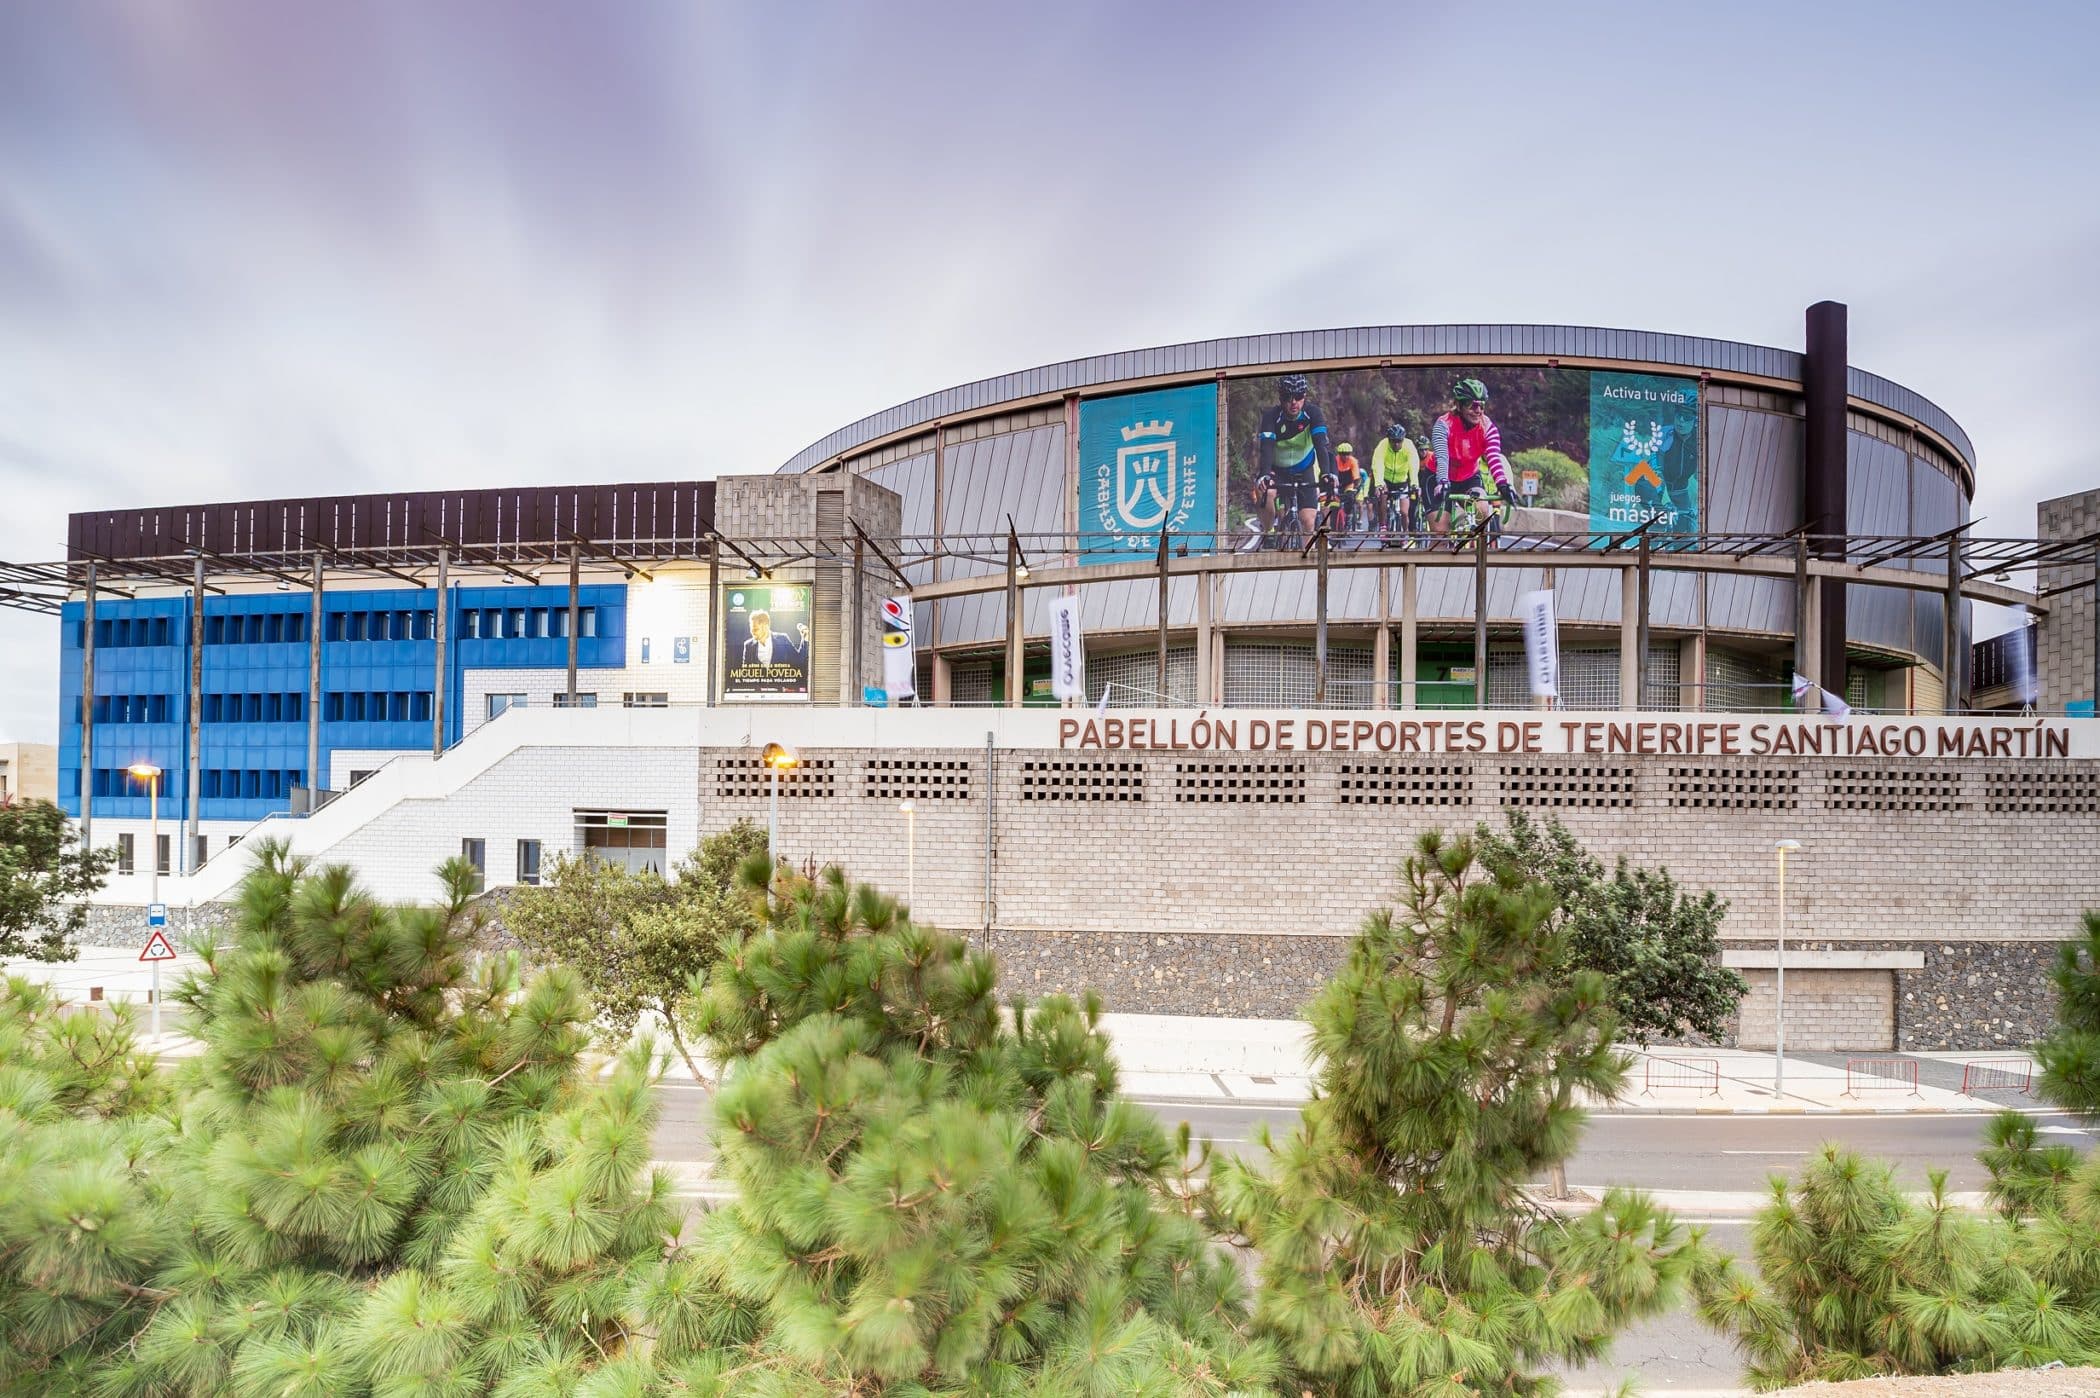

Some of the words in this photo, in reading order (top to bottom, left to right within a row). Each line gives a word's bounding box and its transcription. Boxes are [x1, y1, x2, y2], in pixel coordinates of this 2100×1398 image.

[1603, 385, 1641, 400] Activa
[1645, 389, 1657, 401] tu
[1660, 391, 1685, 404] vida
[1609, 491, 1642, 504] juegos
[1609, 503, 1678, 526] máster
[730, 668, 765, 678] MIGUEL
[766, 668, 803, 678] POVEDA
[1059, 710, 1237, 749] PABELLÓN
[1249, 719, 1295, 750] DE
[1306, 720, 1487, 751] DEPORTES
[1497, 721, 1543, 753] DE
[1560, 722, 1741, 754] TENERIFE
[1750, 723, 1927, 756] SANTIAGO
[1937, 718, 2069, 757] MARTÍN
